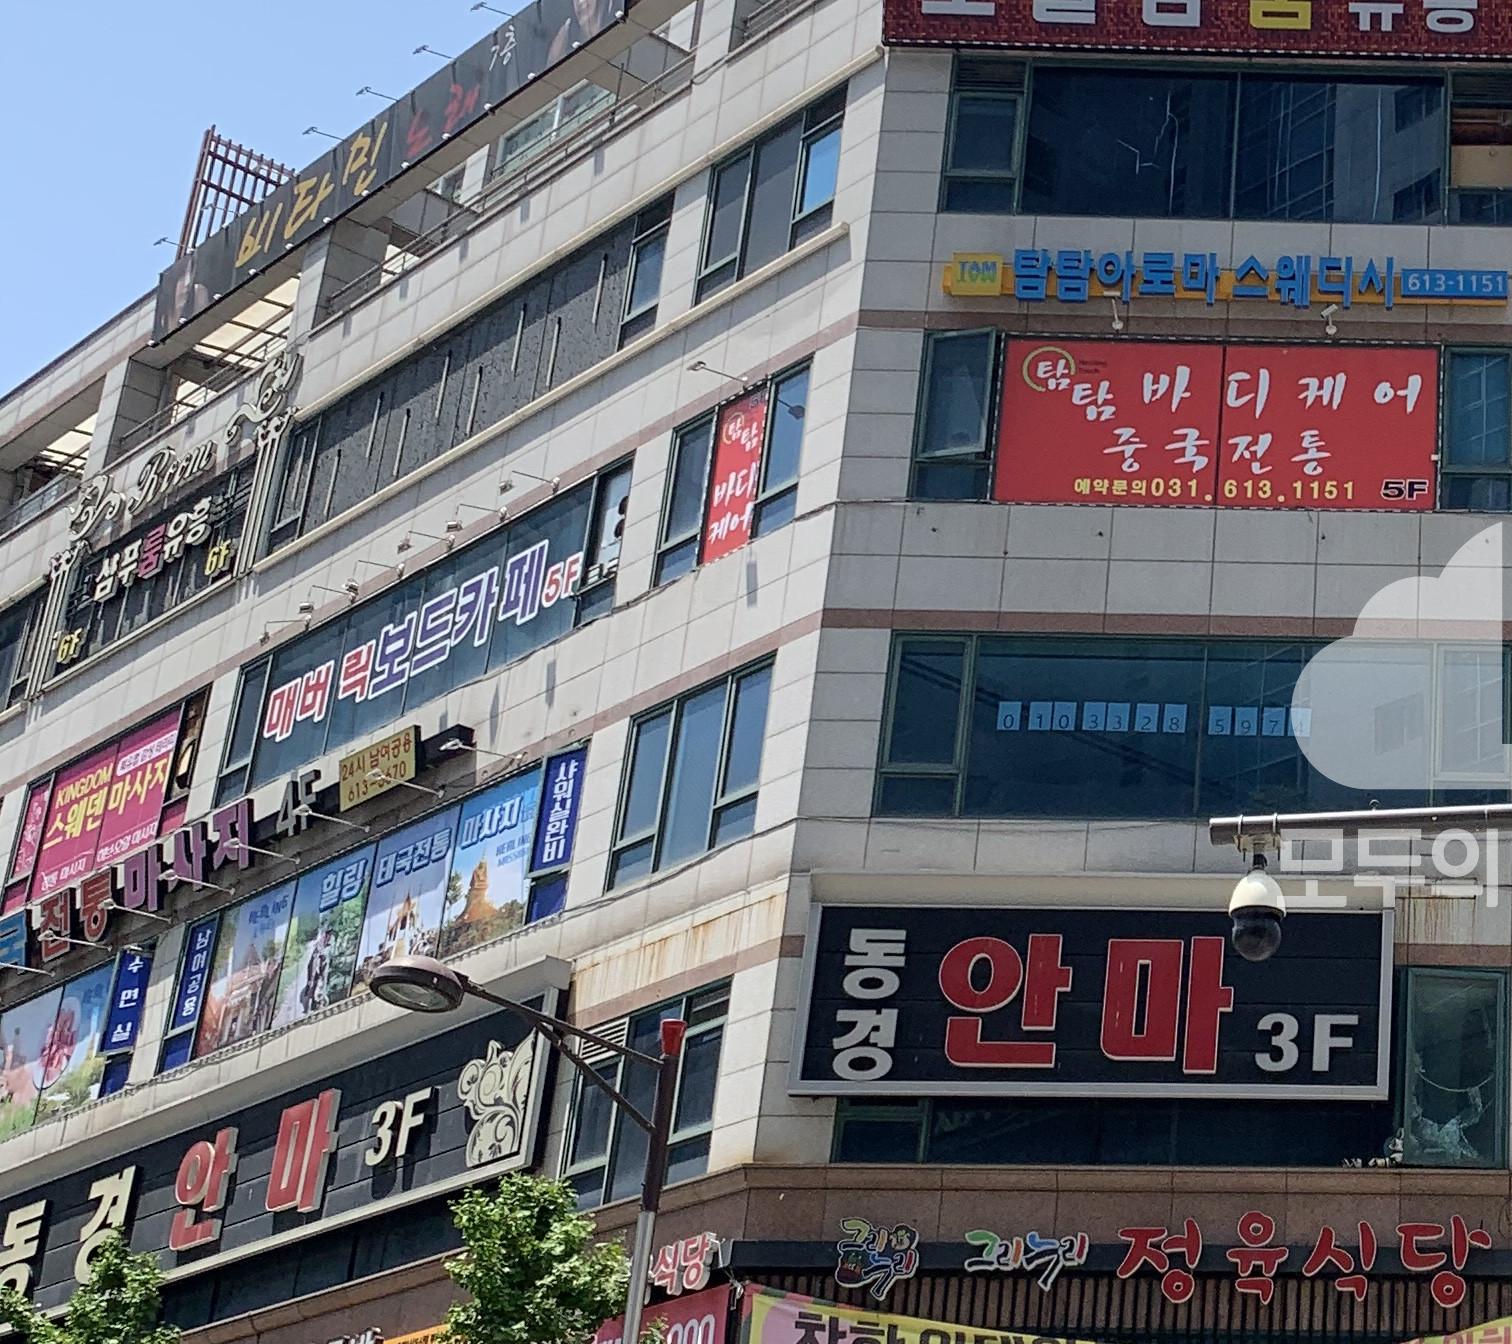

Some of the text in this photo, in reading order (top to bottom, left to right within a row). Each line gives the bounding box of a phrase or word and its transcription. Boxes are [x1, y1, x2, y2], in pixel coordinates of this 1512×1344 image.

[1406, 272, 1507, 294] 613-1151
[1103, 427, 1332, 477] 중국전통
[1074, 478, 1431, 501] 예약문의 5F
[541, 552, 584, 609] 5F
[56, 762, 114, 808] KINGDOM
[276, 766, 322, 837] 4F
[460, 795, 523, 850] 마사지
[831, 928, 1361, 1082] 동경 안마 3F
[169, 1086, 437, 1253] 안마 3F
[1116, 1210, 1493, 1309] 정육식당
